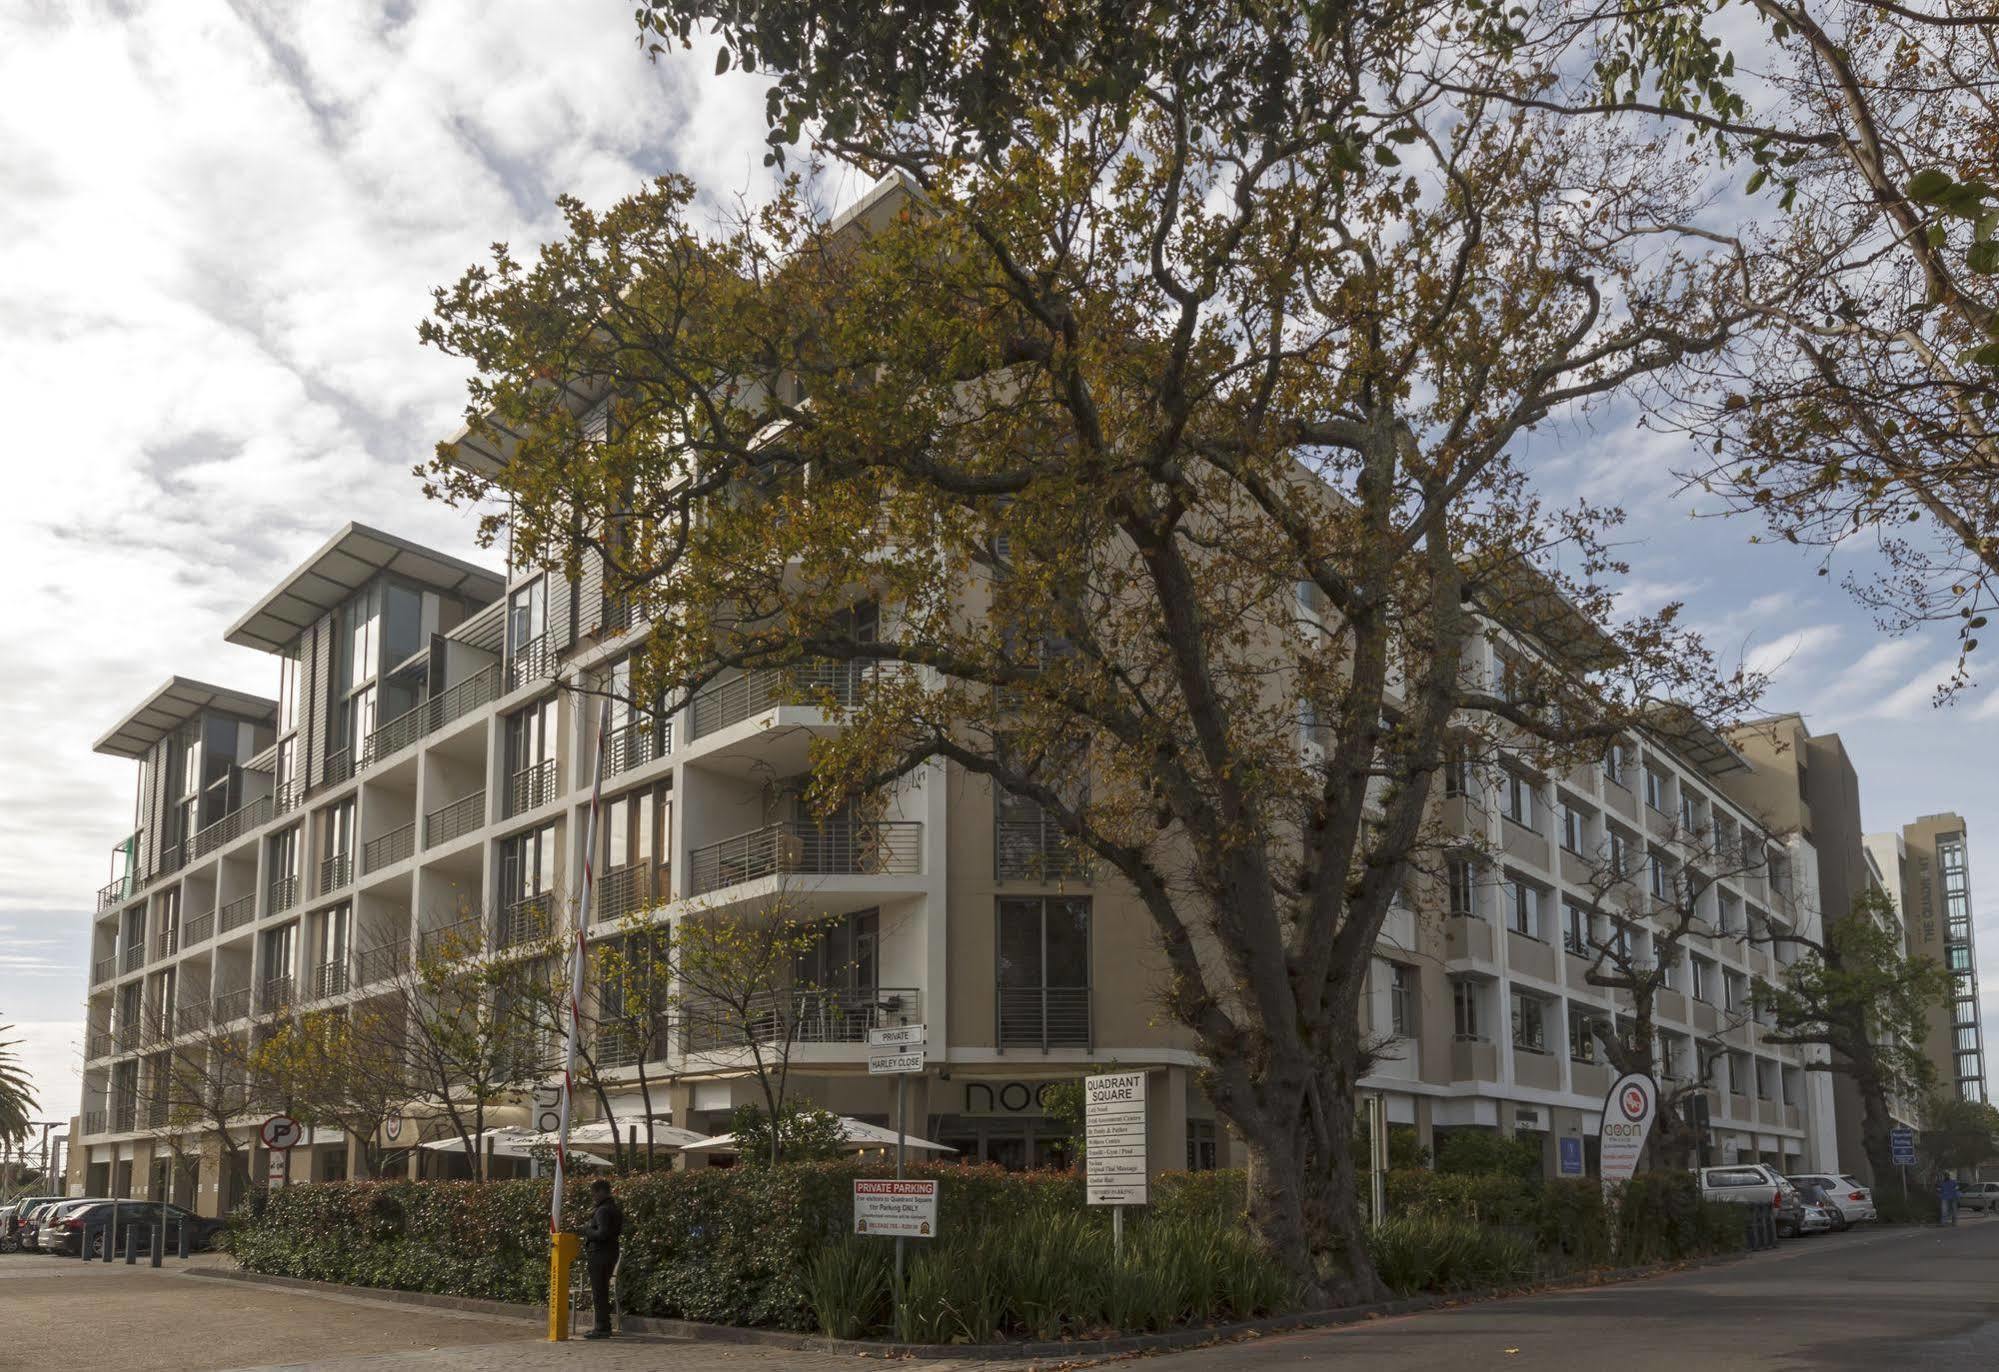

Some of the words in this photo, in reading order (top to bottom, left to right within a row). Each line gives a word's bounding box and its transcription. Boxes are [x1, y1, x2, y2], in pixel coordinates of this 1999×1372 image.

[1922, 920, 1936, 944] THE
[882, 1031, 909, 1041] PRIVATE
[872, 1059, 896, 1068] HARLEY
[898, 1057, 920, 1067] CLOSE
[1088, 1076, 1140, 1090] QUADRANT
[1092, 1089, 1132, 1101] SQUARE
[857, 1183, 892, 1193] PRIVATE
[893, 1183, 933, 1194] PARKING
[880, 1204, 901, 1212] Parking
